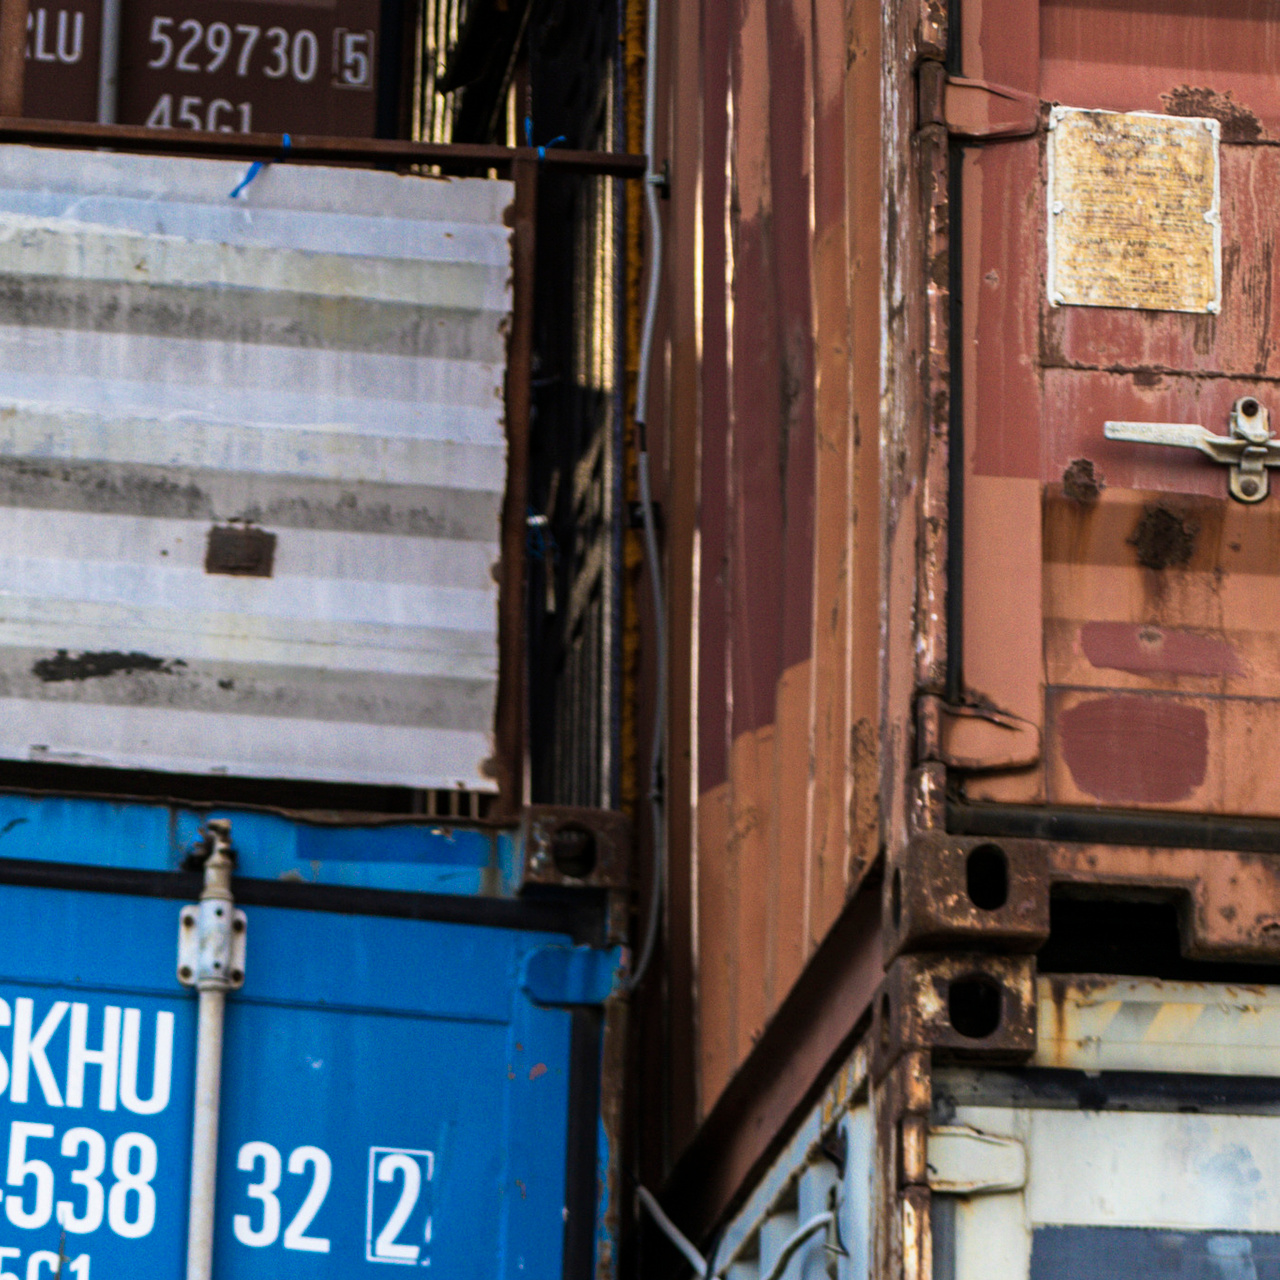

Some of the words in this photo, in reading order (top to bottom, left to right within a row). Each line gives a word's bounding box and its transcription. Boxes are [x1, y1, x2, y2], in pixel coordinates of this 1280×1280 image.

[24, 8, 84, 63] LU
[148, 16, 319, 81] 529730
[342, 33, 368, 84] 5
[233, 1141, 332, 1253] 32
[375, 1153, 421, 1260] 2
